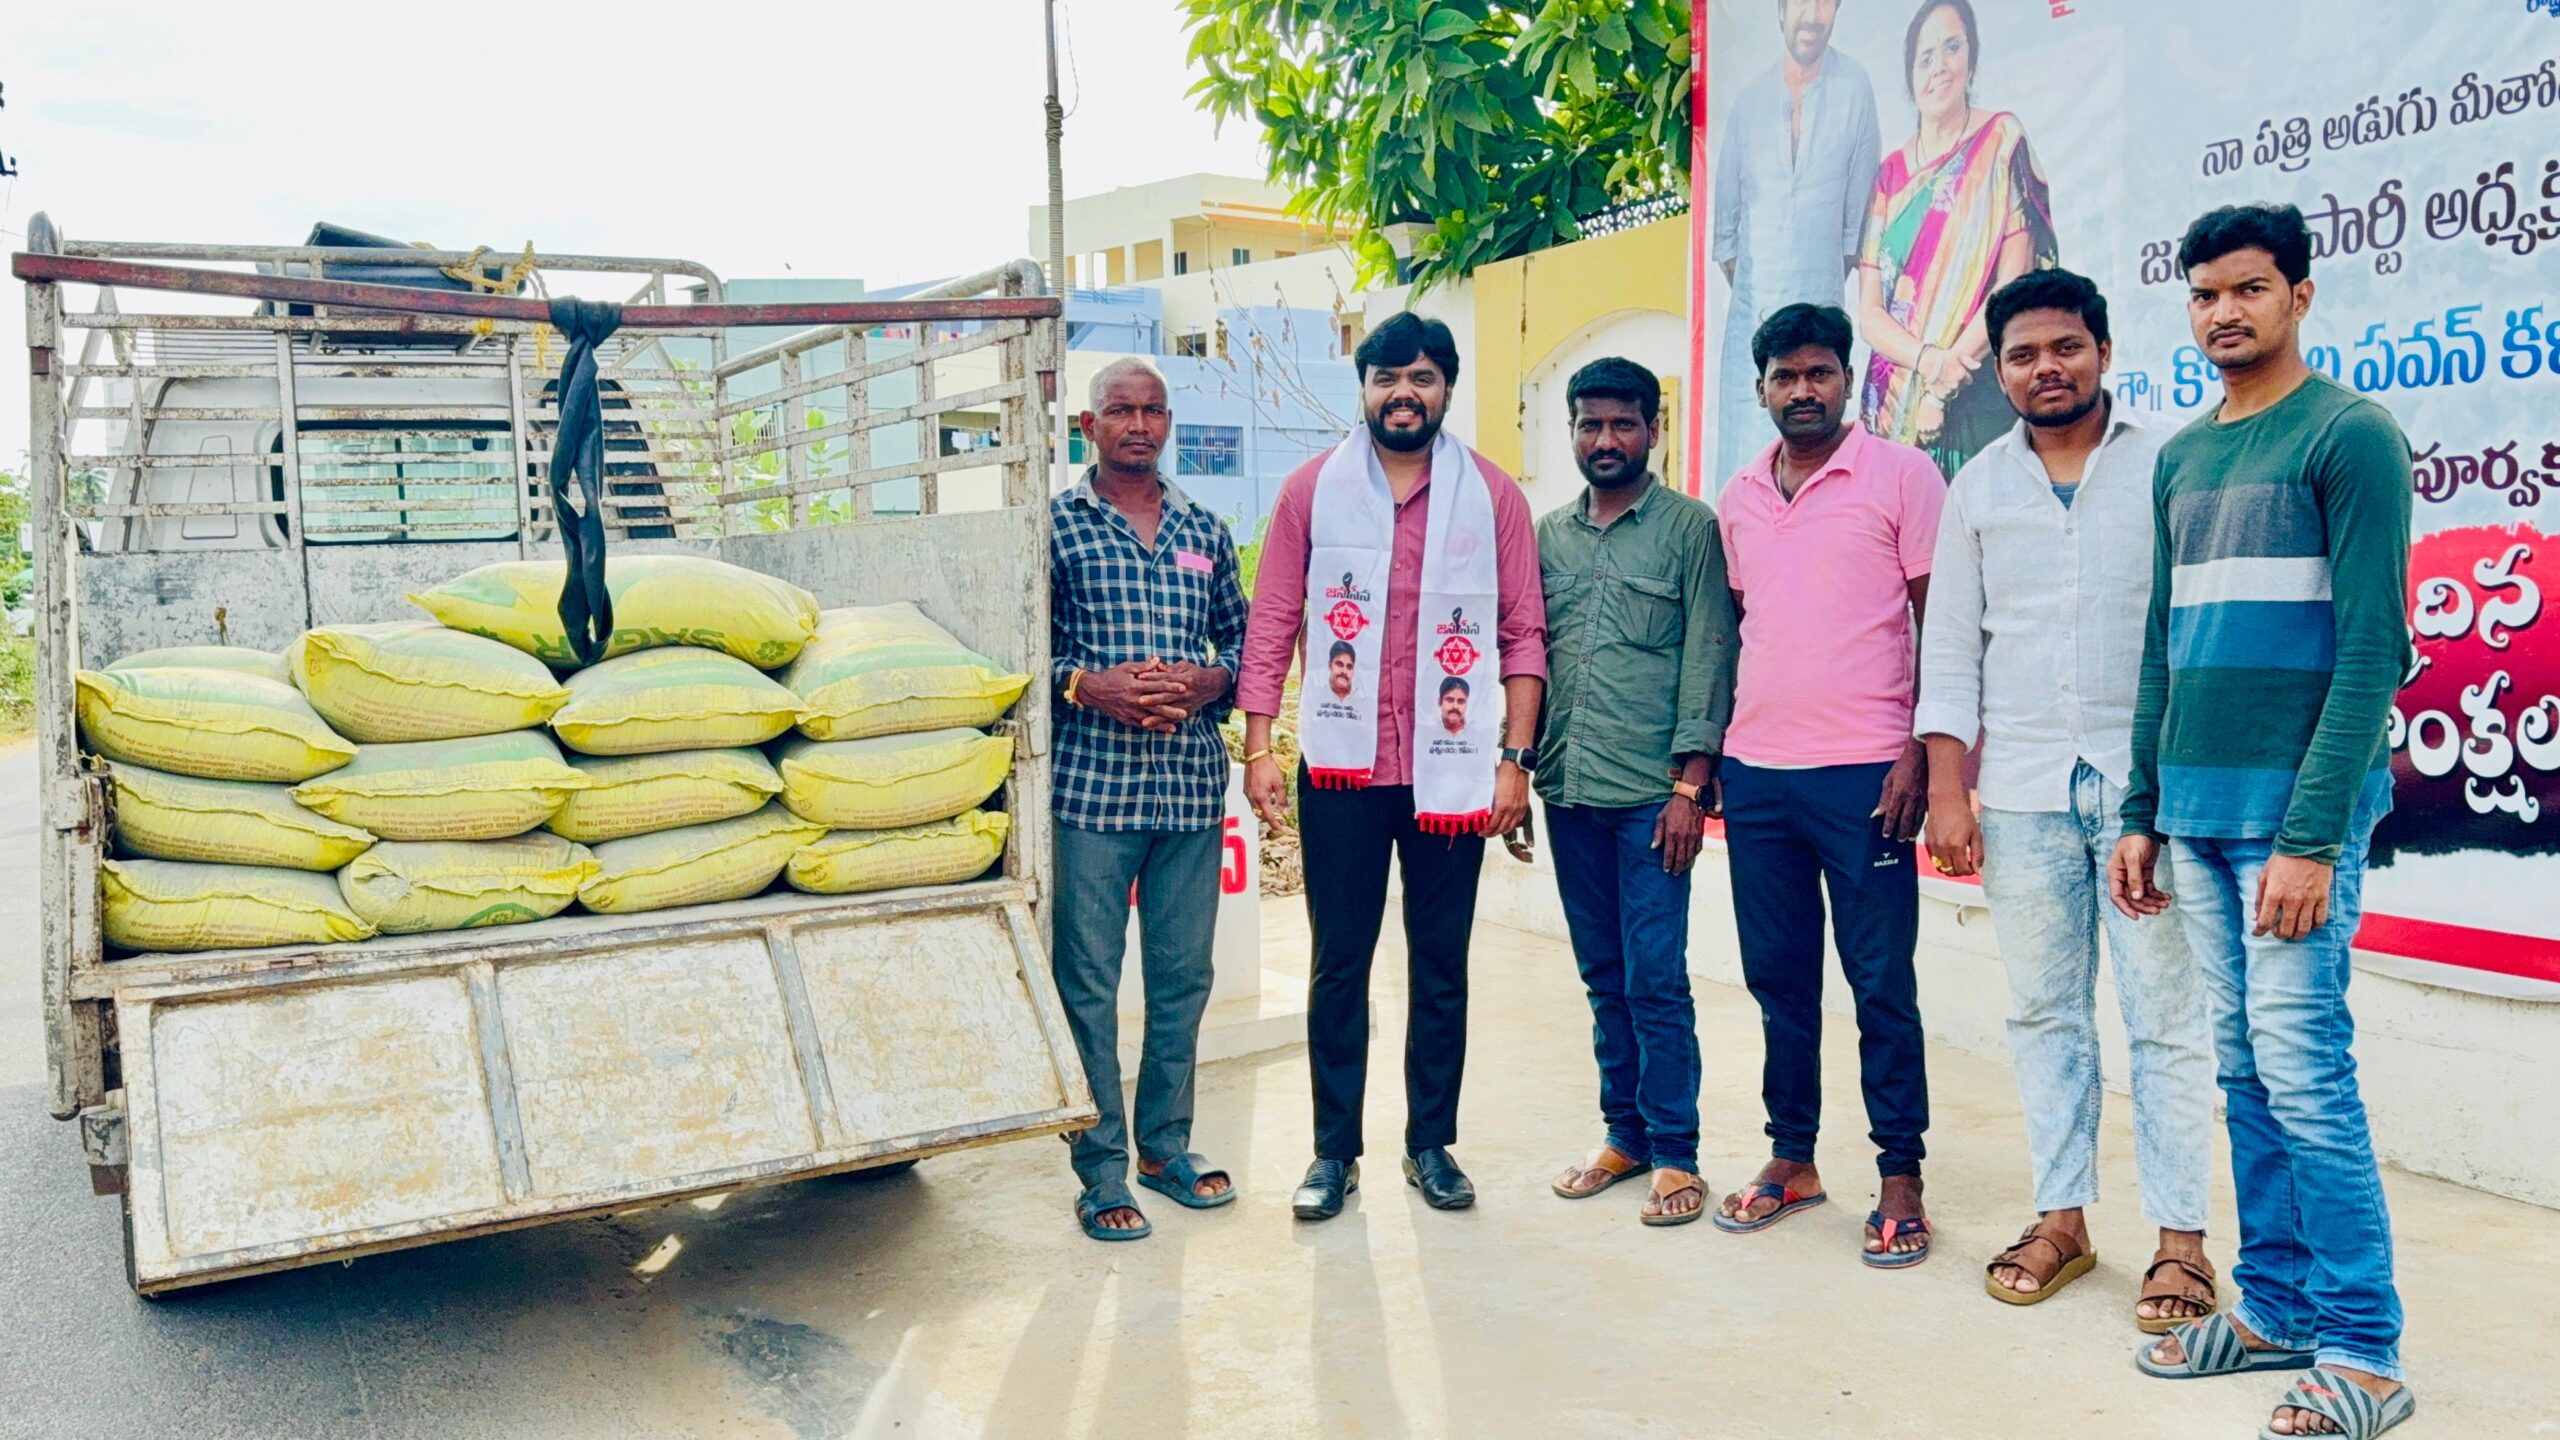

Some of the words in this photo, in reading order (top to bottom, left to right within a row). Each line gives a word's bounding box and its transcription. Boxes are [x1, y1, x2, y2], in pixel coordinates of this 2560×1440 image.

[2202, 137, 2244, 177] నా
[2322, 86, 2438, 151] అడుగు
[2450, 57, 2560, 126] మీతో
[2353, 302, 2487, 393] పవన్
[534, 626, 724, 661] SAGR
